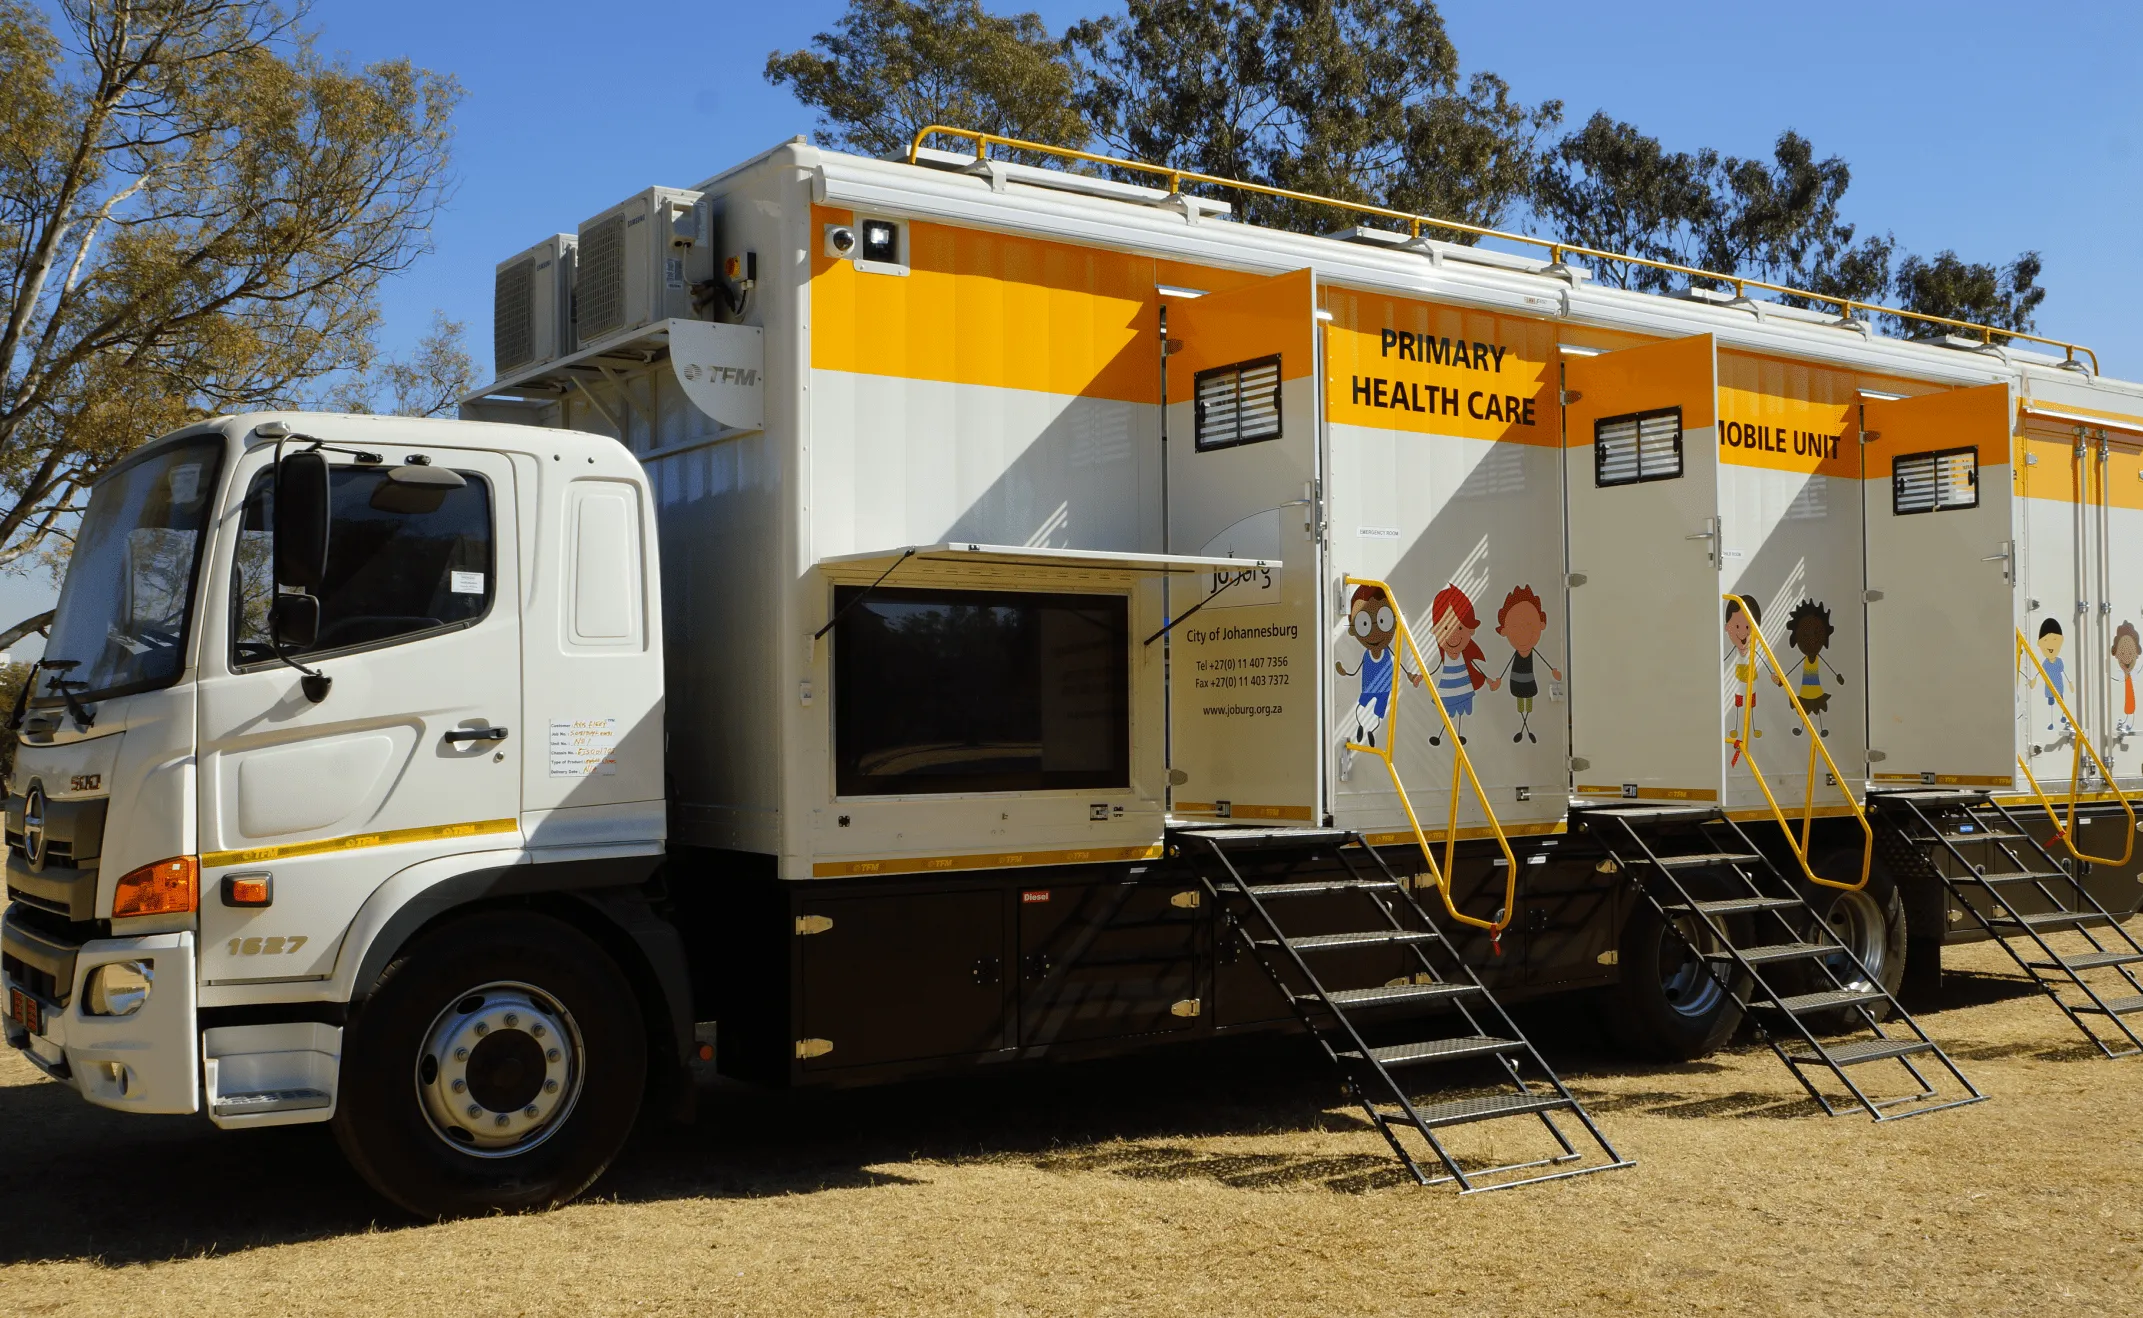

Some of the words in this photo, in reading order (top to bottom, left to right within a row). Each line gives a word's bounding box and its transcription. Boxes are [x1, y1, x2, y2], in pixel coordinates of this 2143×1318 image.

[1381, 328, 1506, 374] PRIMARY
[707, 365, 757, 387] TFM
[1352, 375, 1460, 417] HEALTH
[1467, 391, 1536, 427] CARE
[1793, 430, 1841, 460] UNIT
[1187, 629, 1207, 645] City
[1209, 626, 1220, 641] of
[1222, 623, 1298, 640] Johannesburg
[1196, 660, 1208, 671] Tel
[1209, 658, 1236, 672] +27(0)
[1238, 658, 1247, 668] 11
[1250, 657, 1265, 668] 407
[1267, 656, 1288, 668] 7356
[1196, 678, 1208, 688] Fax
[1210, 676, 1237, 690] +27(0)
[1239, 676, 1248, 687] 11
[1250, 675, 1266, 686] 403
[1268, 674, 1290, 686] 7372
[1203, 704, 1282, 718] www.joburg.org.za
[452, 824, 475, 836] TFM
[355, 836, 380, 847] TFM
[254, 847, 279, 859] TFM
[860, 863, 880, 872] TFM
[934, 859, 953, 868] TFM
[1023, 892, 1050, 902] Diesel
[228, 935, 309, 957] 1627
